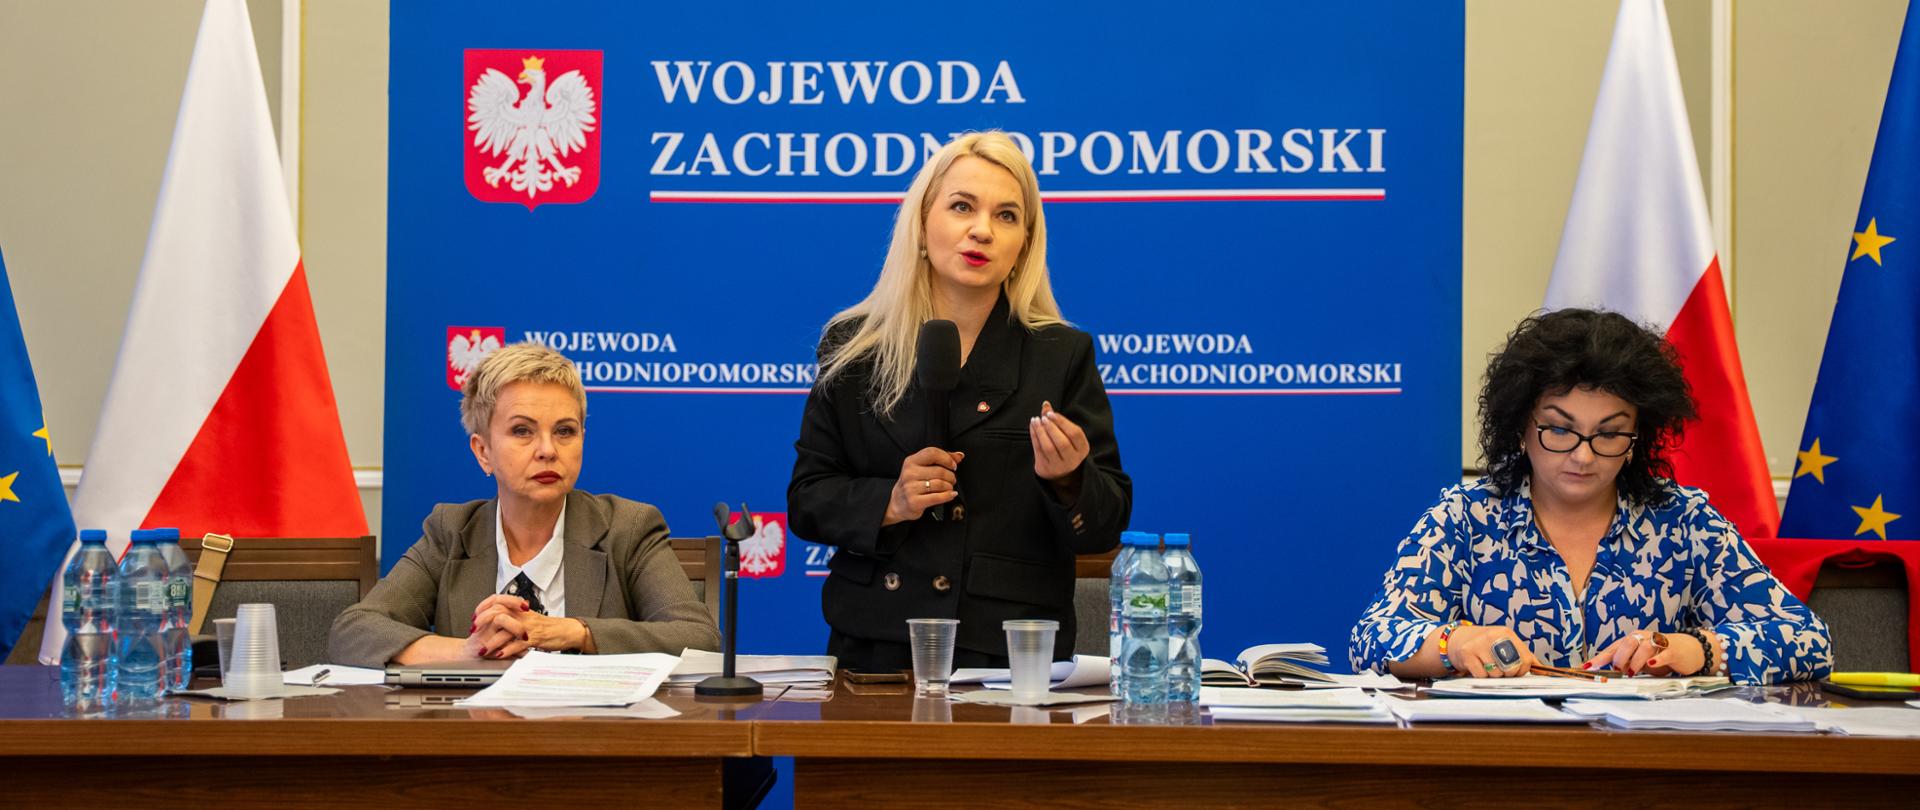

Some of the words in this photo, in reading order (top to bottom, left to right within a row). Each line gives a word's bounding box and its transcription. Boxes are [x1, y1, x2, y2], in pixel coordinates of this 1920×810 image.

[650, 60, 1026, 105] WOJEWODA
[650, 129, 1386, 176] ZACHODPOMORSKI
[524, 331, 677, 352] WOJEWODA
[1098, 334, 1253, 354] WOJEWODA
[576, 362, 820, 383] HODNIOPOMORSK
[1098, 363, 1402, 384] ZACHODNIOPOMORSKI
